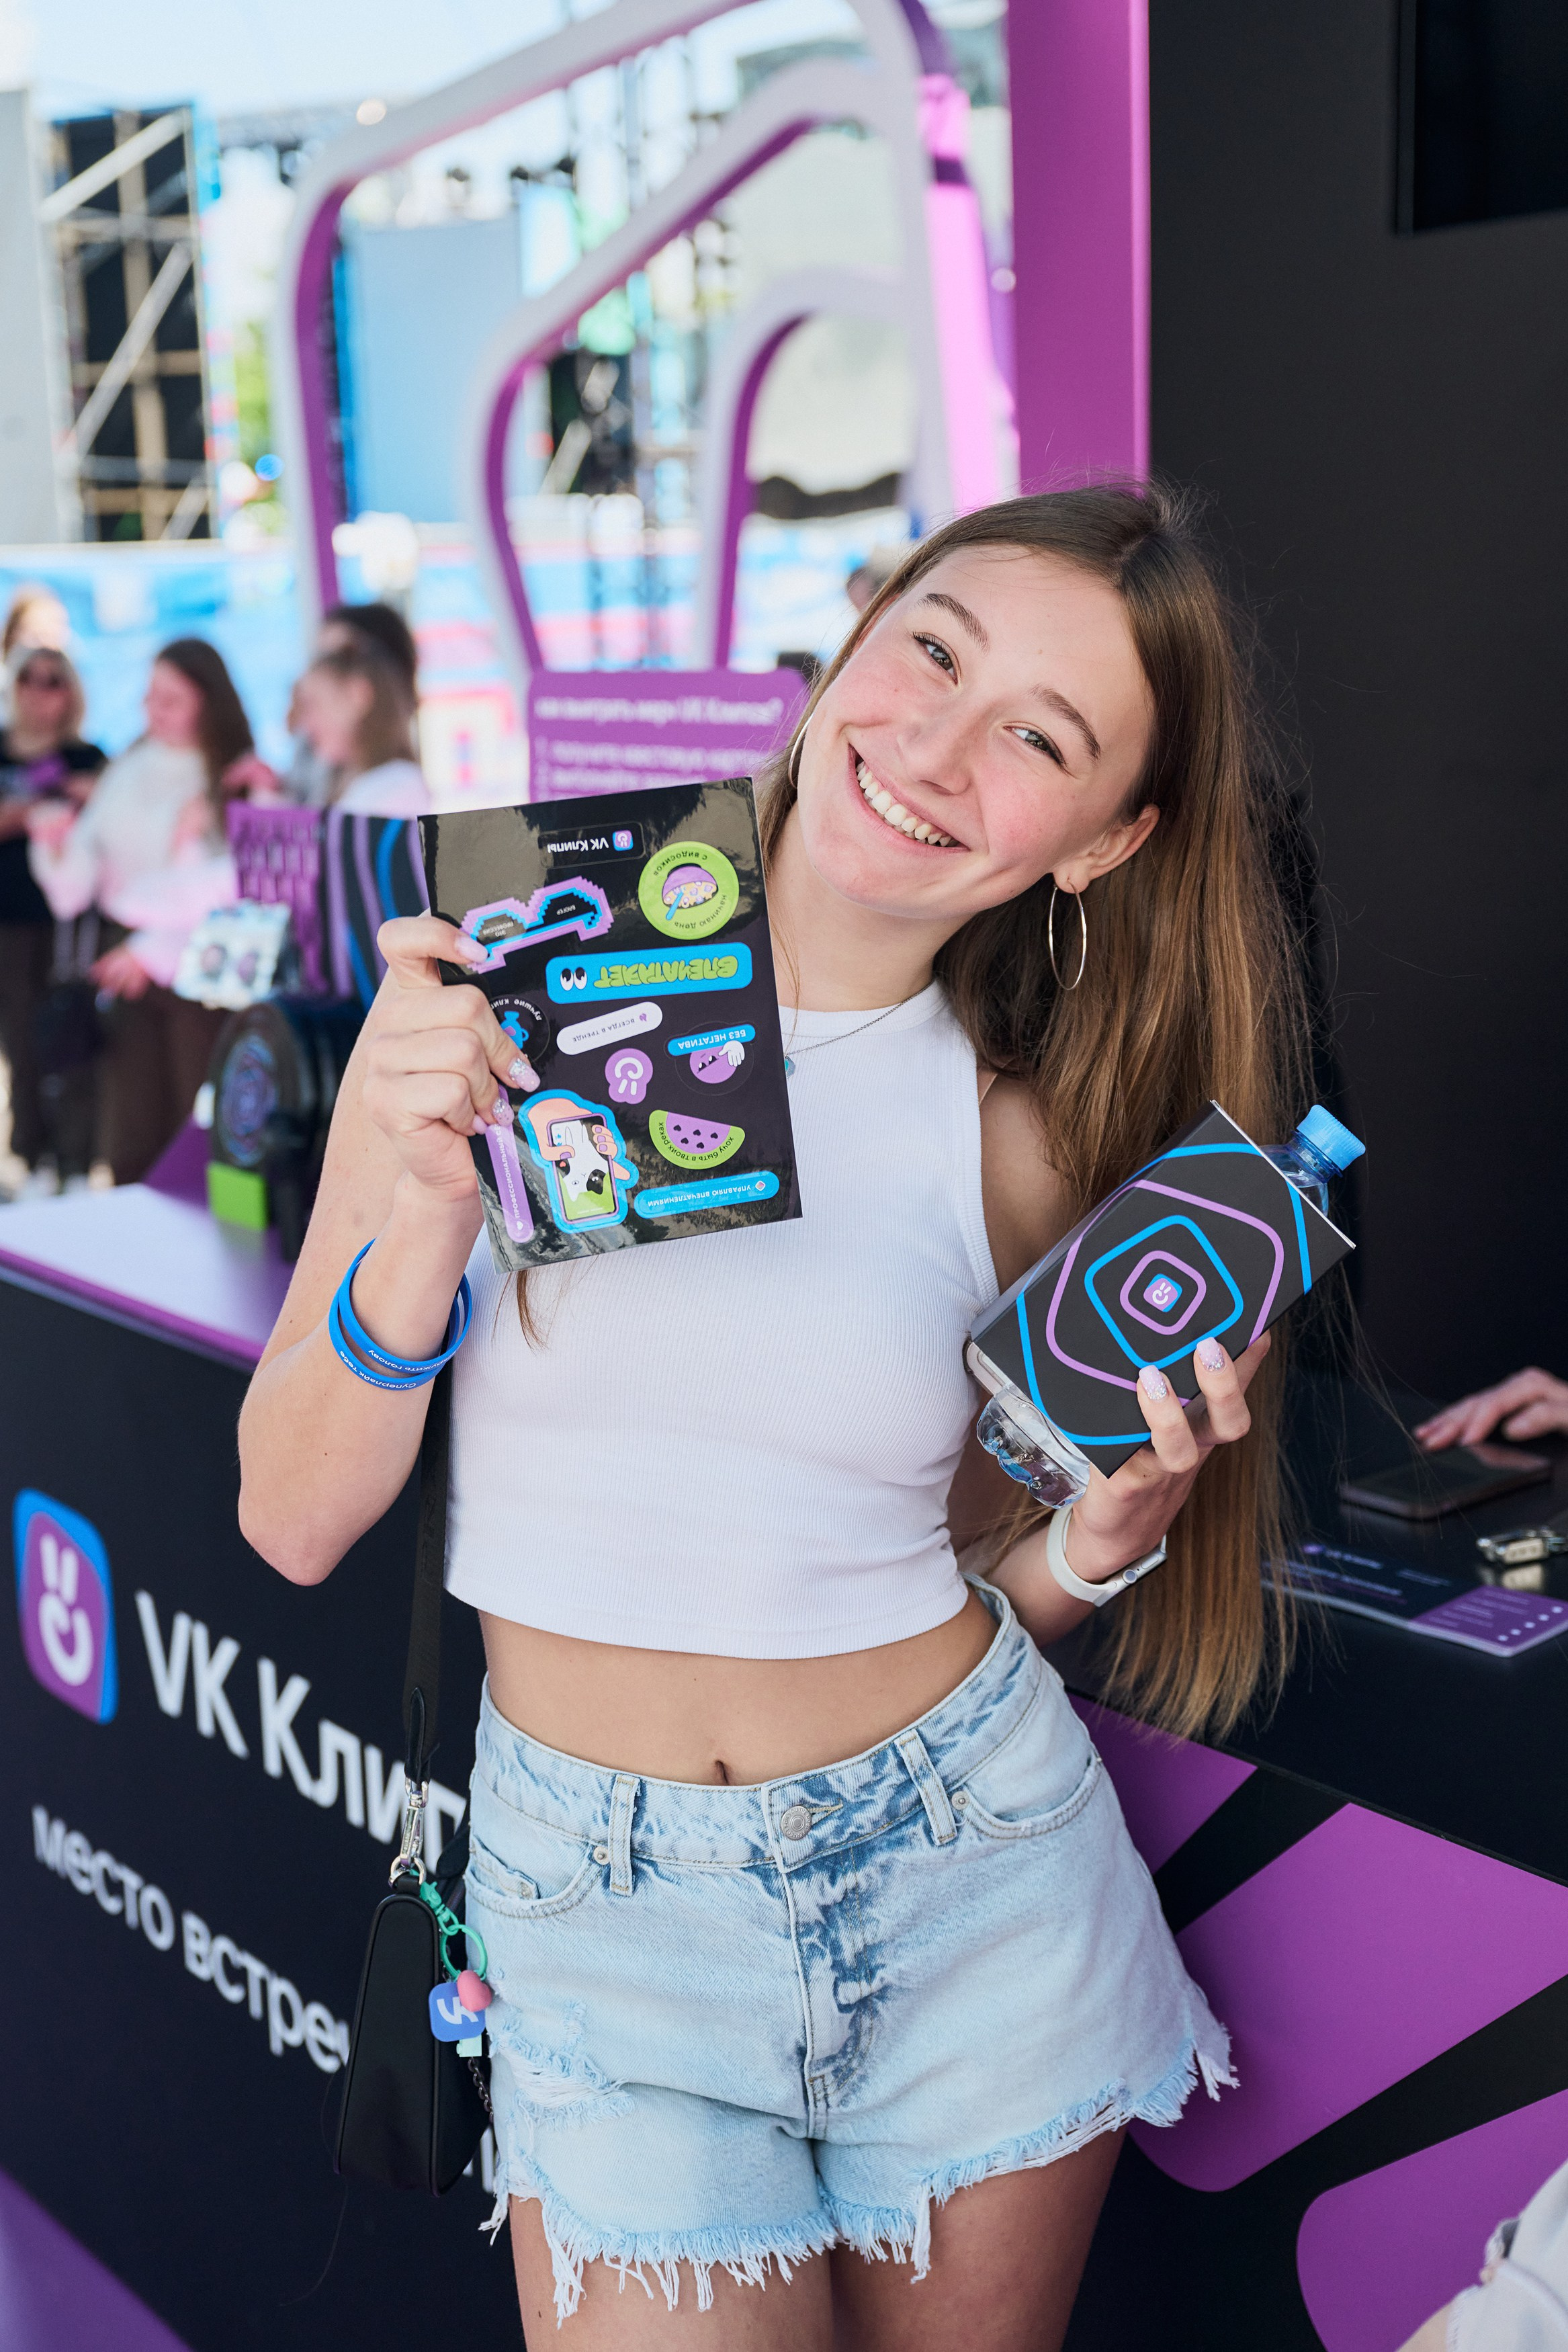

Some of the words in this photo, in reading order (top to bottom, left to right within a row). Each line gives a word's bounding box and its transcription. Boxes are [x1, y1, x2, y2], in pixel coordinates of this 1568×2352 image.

[547, 839, 589, 853] Клипы
[591, 837, 609, 851] VK
[654, 851, 699, 876] видосиков
[556, 905, 576, 915] БЛОГЕР
[699, 894, 727, 927] начинаю
[482, 921, 514, 935] ПРОФЕССИЯ
[674, 921, 697, 929] день
[593, 955, 738, 989] ВПЕЧАТЛЯЕТ
[514, 999, 542, 1021] лучшие
[607, 1017, 635, 1031] ВСЕГДА
[573, 1030, 600, 1043] ТРЕНДЕ
[677, 1034, 727, 1050] НЕГАТИВА
[728, 1029, 746, 1040] БЕЗ
[658, 1122, 671, 1146] реках
[668, 1144, 689, 1161] твоих
[720, 1136, 734, 1153] хочу
[699, 1151, 719, 1161] быть
[498, 1136, 521, 1219] ПРОФЕССИОНАЛЬНЫЙ
[712, 1185, 752, 1196] УПРАВЛЯЮ
[648, 1191, 711, 1208] ВПЕЧАТЛЕНИЯМИ
[339, 1349, 358, 1372] тебе
[367, 1349, 402, 1370] голову
[359, 1371, 417, 1389] Суперлайк
[136, 1590, 251, 1759] VK
[257, 1657, 466, 1875] Клип
[32, 1804, 175, 1951] место
[181, 1910, 350, 2074] встре
